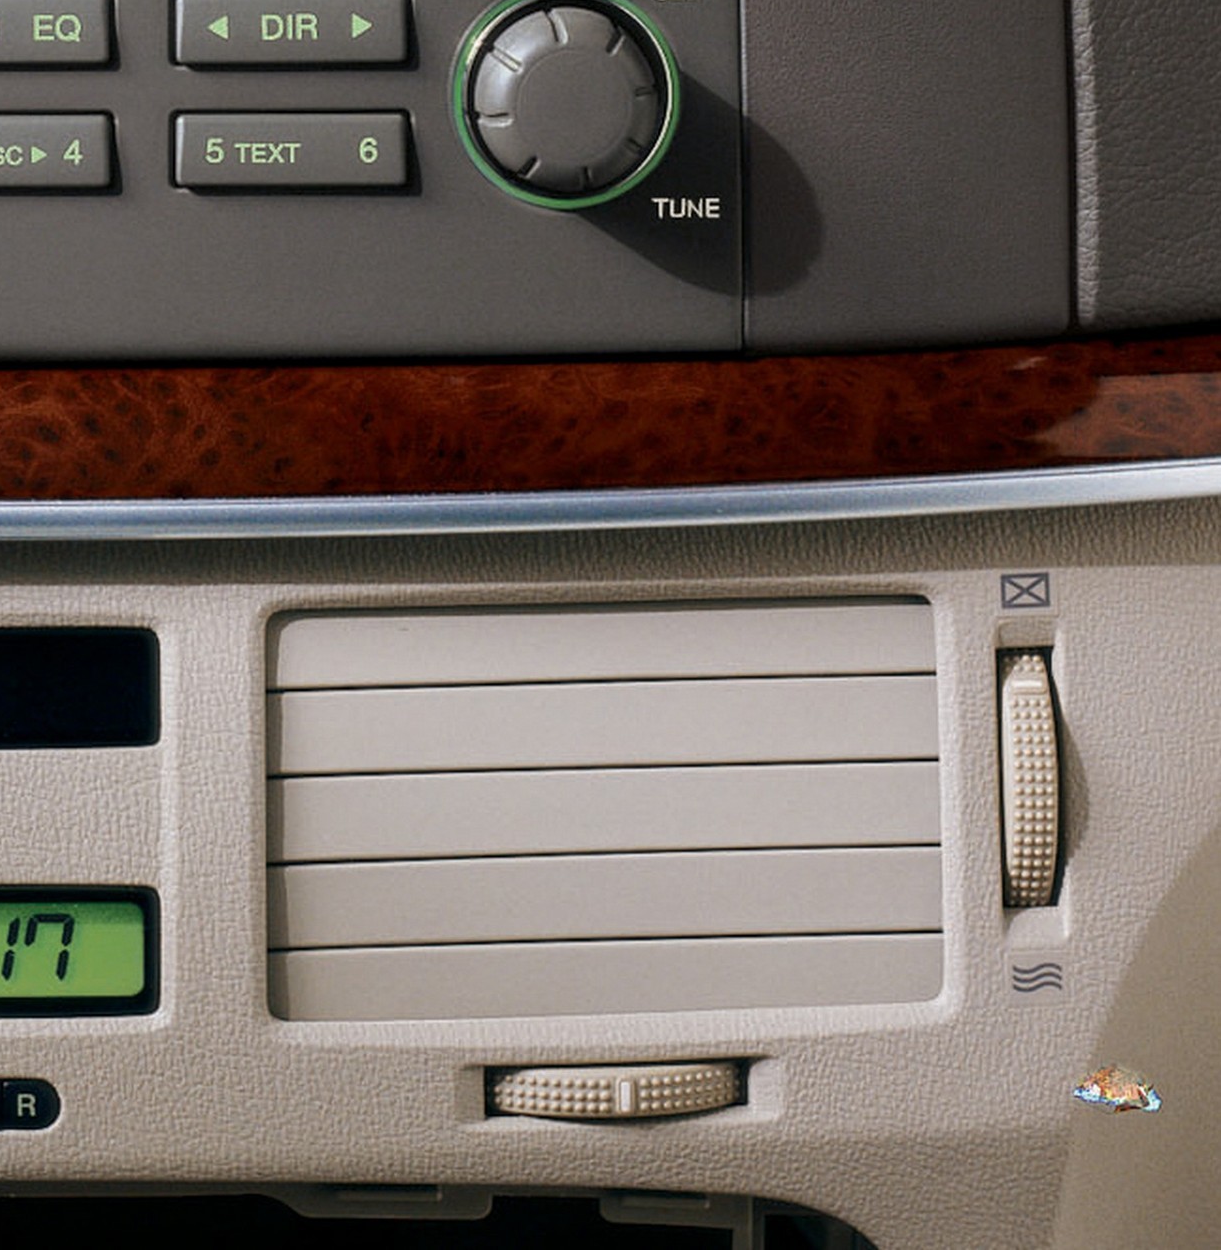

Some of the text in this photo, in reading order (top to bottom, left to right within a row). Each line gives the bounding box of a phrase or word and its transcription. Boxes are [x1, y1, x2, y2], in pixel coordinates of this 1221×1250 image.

[33, 14, 81, 43] EQ
[261, 15, 318, 40] DIR
[63, 141, 82, 164] 4
[205, 139, 378, 163] 5 TEXT 6
[651, 198, 721, 218] TUNE
[17, 1093, 37, 1116] R
